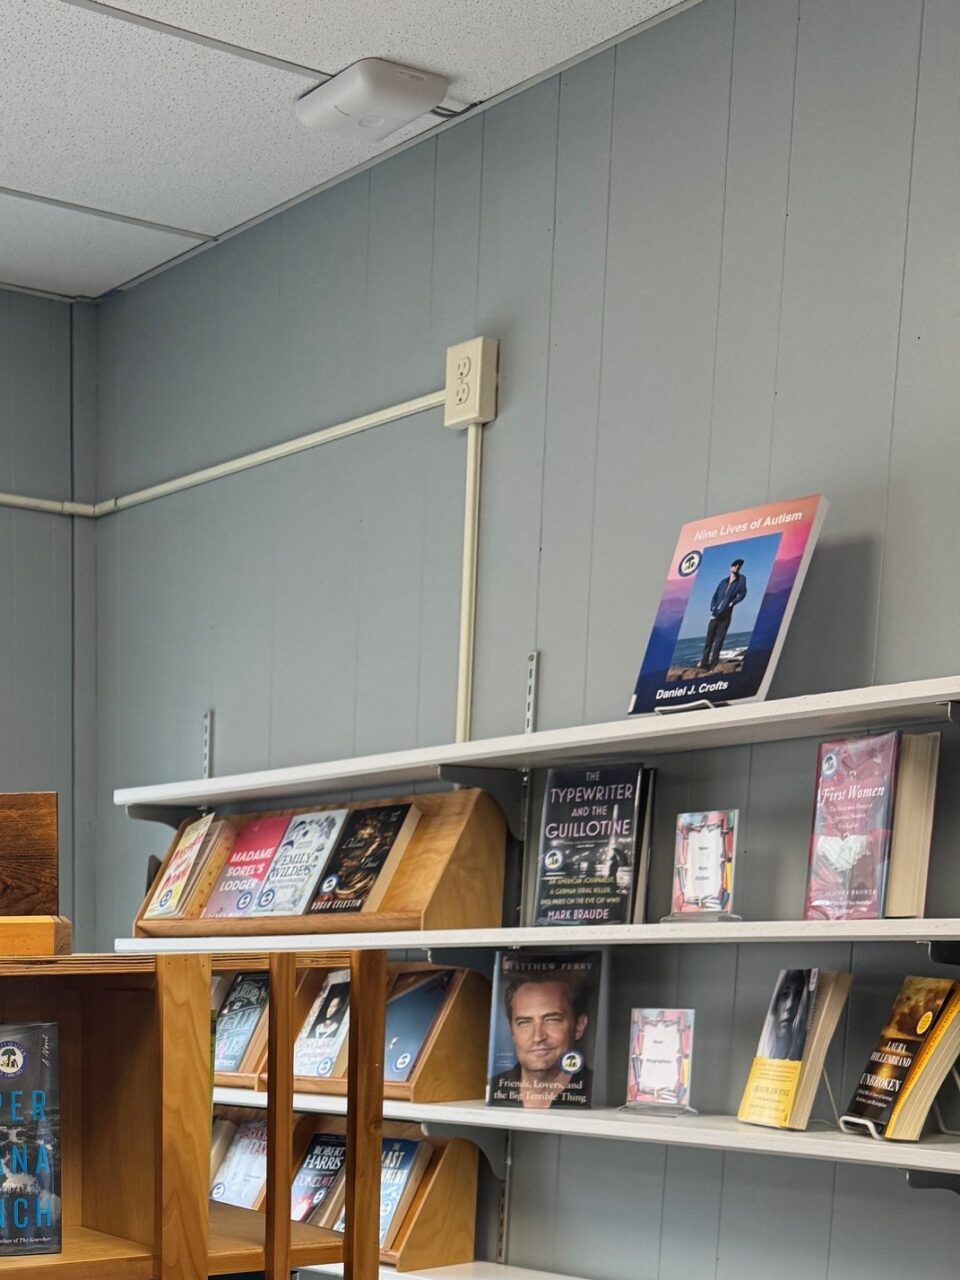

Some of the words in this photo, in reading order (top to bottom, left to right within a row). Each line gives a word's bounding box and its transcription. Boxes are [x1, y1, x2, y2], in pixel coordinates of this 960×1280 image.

[694, 528, 717, 542] Nine
[719, 523, 747, 537] Lives
[750, 518, 762, 530] of
[764, 511, 803, 527] Autism
[655, 685, 686, 700] Daniel
[687, 684, 696, 695] J.
[698, 680, 729, 694] Crofts
[585, 771, 601, 781] THE
[550, 783, 633, 803] TYPEWRITER
[820, 788, 846, 806] First
[848, 785, 885, 799] Women
[571, 806, 590, 817] AND
[591, 805, 608, 816] THE
[545, 818, 631, 839] GUILLOTINE
[230, 847, 276, 863] MADAME
[226, 863, 266, 877] SOREL'S
[219, 878, 258, 892] LODGER
[547, 909, 572, 920] MARK
[573, 908, 609, 919] BRAUDE
[886, 1041, 907, 1052] LAURA
[870, 1051, 912, 1068] HILLENBRAND
[498, 1079, 532, 1089] Friends,
[860, 1072, 902, 1093] UNBROKEN
[494, 1090, 507, 1099] the
[508, 1091, 522, 1101] Big
[561, 1091, 588, 1103] Thing
[312, 1145, 346, 1156] ROBERT
[303, 1154, 344, 1169] HARRIS
